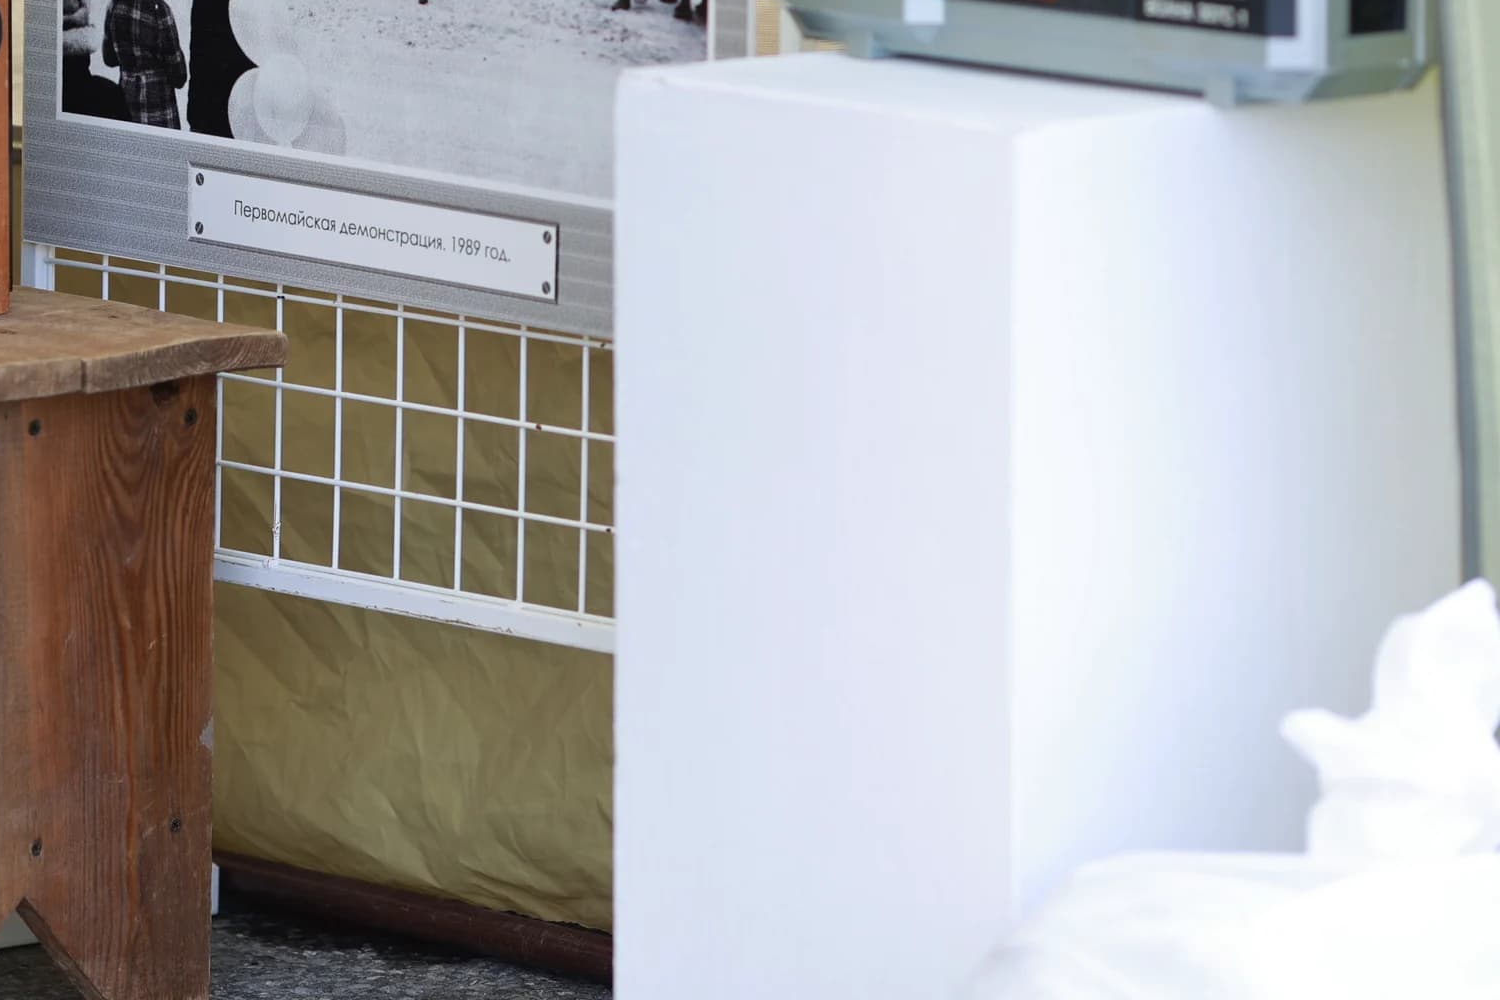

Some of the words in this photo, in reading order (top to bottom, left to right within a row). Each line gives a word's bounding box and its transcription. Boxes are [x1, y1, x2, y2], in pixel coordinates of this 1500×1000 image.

[233, 199, 336, 233] Первомайская
[338, 218, 447, 255] демонстрация.
[450, 235, 482, 257] 1989
[484, 244, 511, 263] год.
